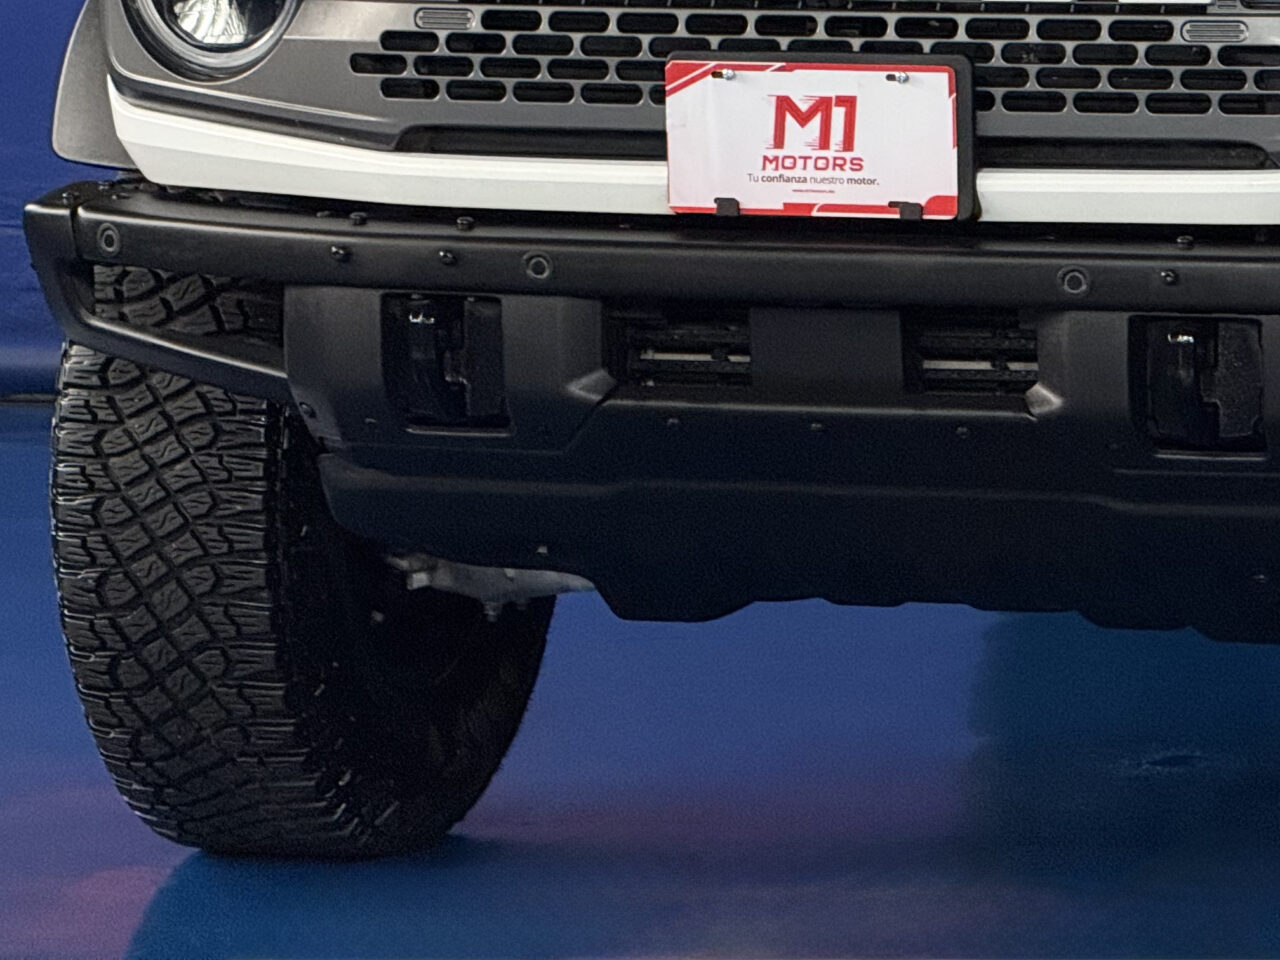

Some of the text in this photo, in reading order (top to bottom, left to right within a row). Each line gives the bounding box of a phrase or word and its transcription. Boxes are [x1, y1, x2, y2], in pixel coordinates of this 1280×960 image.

[766, 95, 857, 152] M1
[761, 155, 864, 171] MOTORS
[747, 173, 879, 186] Tu confianza nuestro motor.
